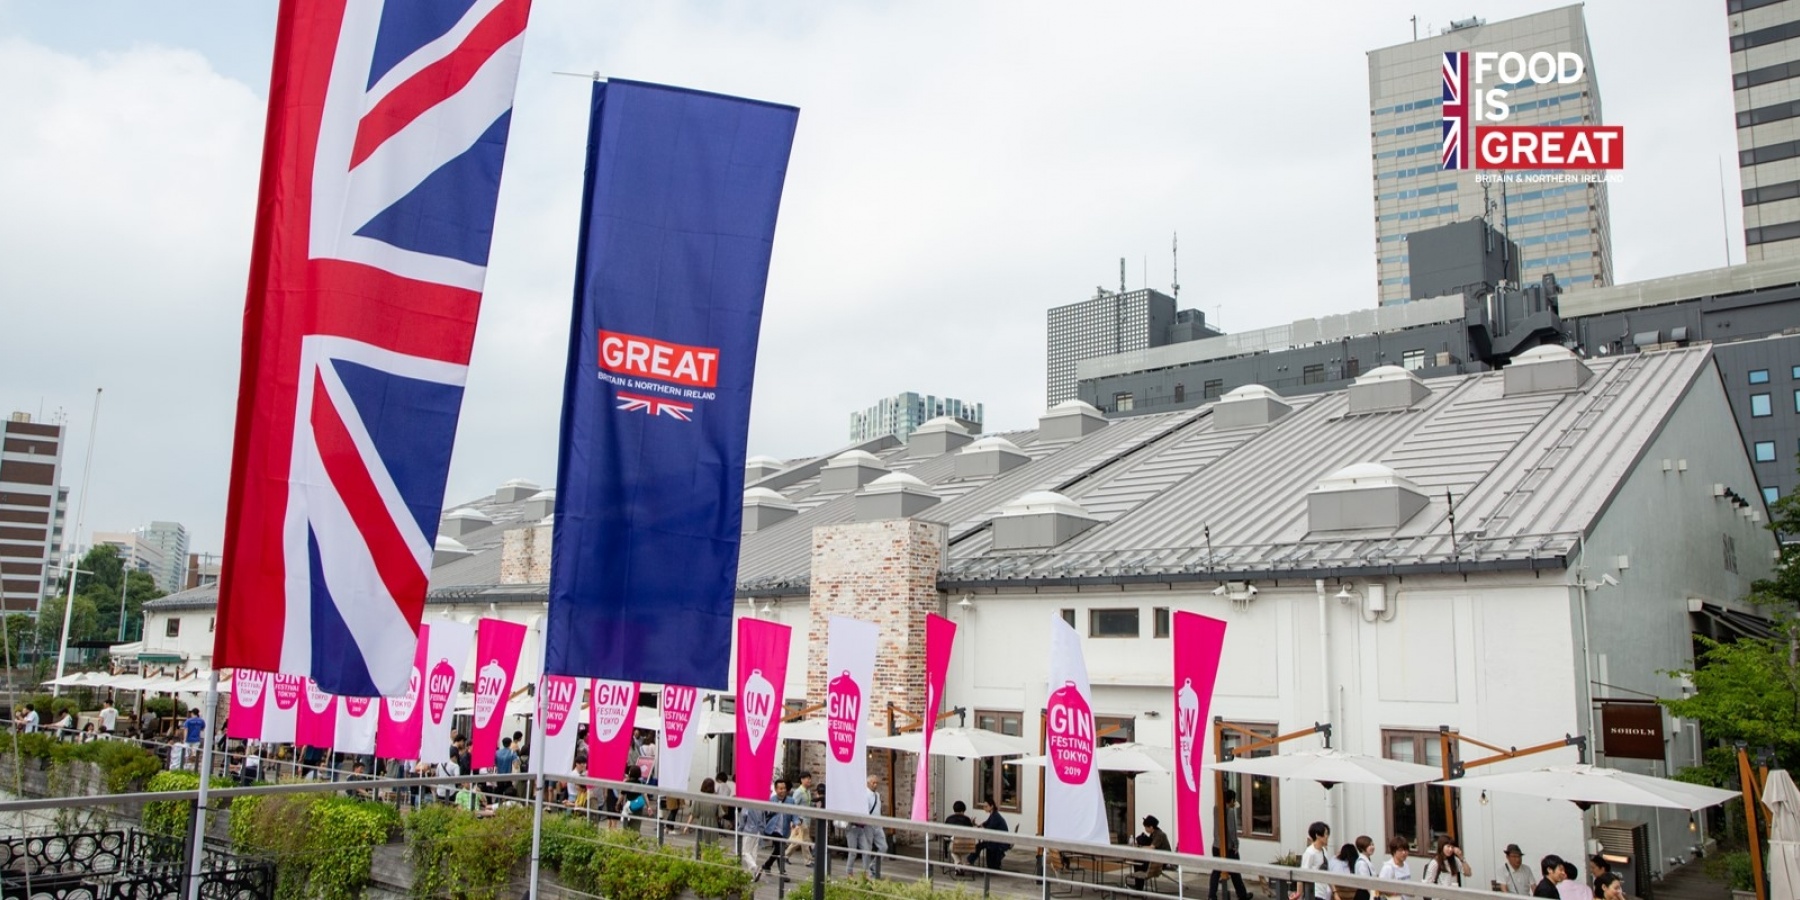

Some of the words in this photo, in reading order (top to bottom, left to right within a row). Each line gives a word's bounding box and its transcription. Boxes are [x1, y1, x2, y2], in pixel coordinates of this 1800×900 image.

[602, 337, 716, 382] GREAT
[598, 371, 626, 388] BRITAIN
[627, 379, 633, 388] &
[635, 380, 682, 396] NORTHERN
[683, 389, 716, 401] IRELAND
[238, 668, 264, 682] GIN
[275, 673, 300, 684] GIN
[237, 681, 262, 689] FESTIVAL
[430, 674, 453, 694] GIN
[477, 676, 502, 696] GIN
[311, 693, 329, 701] TOKYO
[476, 697, 496, 705] ESTIVAL
[598, 684, 630, 707] GIN
[664, 686, 693, 711] GIN
[391, 700, 412, 709] TOKYO
[828, 692, 858, 720] GIN
[546, 710, 564, 720] OKYO
[597, 707, 625, 717] FESTIVAL
[600, 717, 620, 726] TOKYO
[828, 719, 855, 733] FESTIVAL
[1050, 704, 1092, 741] GIN
[833, 731, 853, 744] TOKYO
[1050, 735, 1092, 754] FESTIVAL
[1056, 748, 1088, 764] TOKYO
[1063, 765, 1081, 776] 2019
